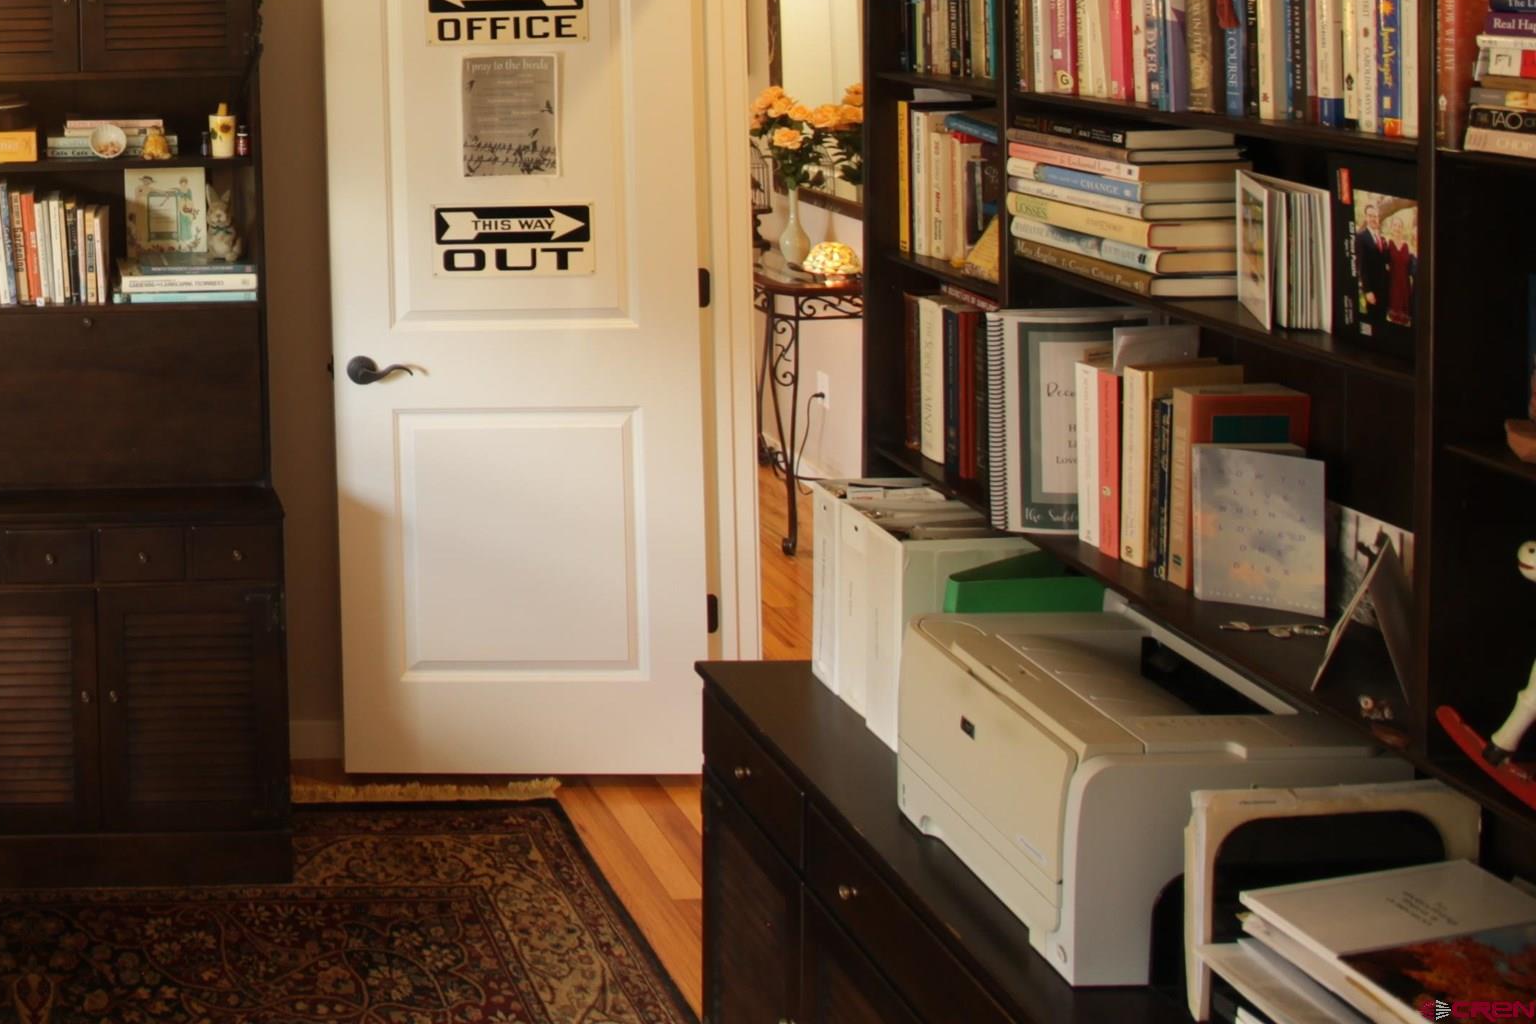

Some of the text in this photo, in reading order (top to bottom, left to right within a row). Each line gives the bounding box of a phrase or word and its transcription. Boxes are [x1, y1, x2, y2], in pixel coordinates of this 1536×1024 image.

[437, 15, 577, 42] OFFICE
[1493, 17, 1516, 29] Real
[1445, 0, 1456, 72] HOW WE LIVE
[472, 62, 491, 75] pray
[494, 62, 503, 70] to
[505, 60, 519, 70] the
[1228, 37, 1238, 87] COURSE
[1490, 111, 1523, 130] TAO
[1080, 179, 1120, 193] CHANGE
[471, 218, 557, 231] THIS WAY
[443, 248, 584, 272] OUT
